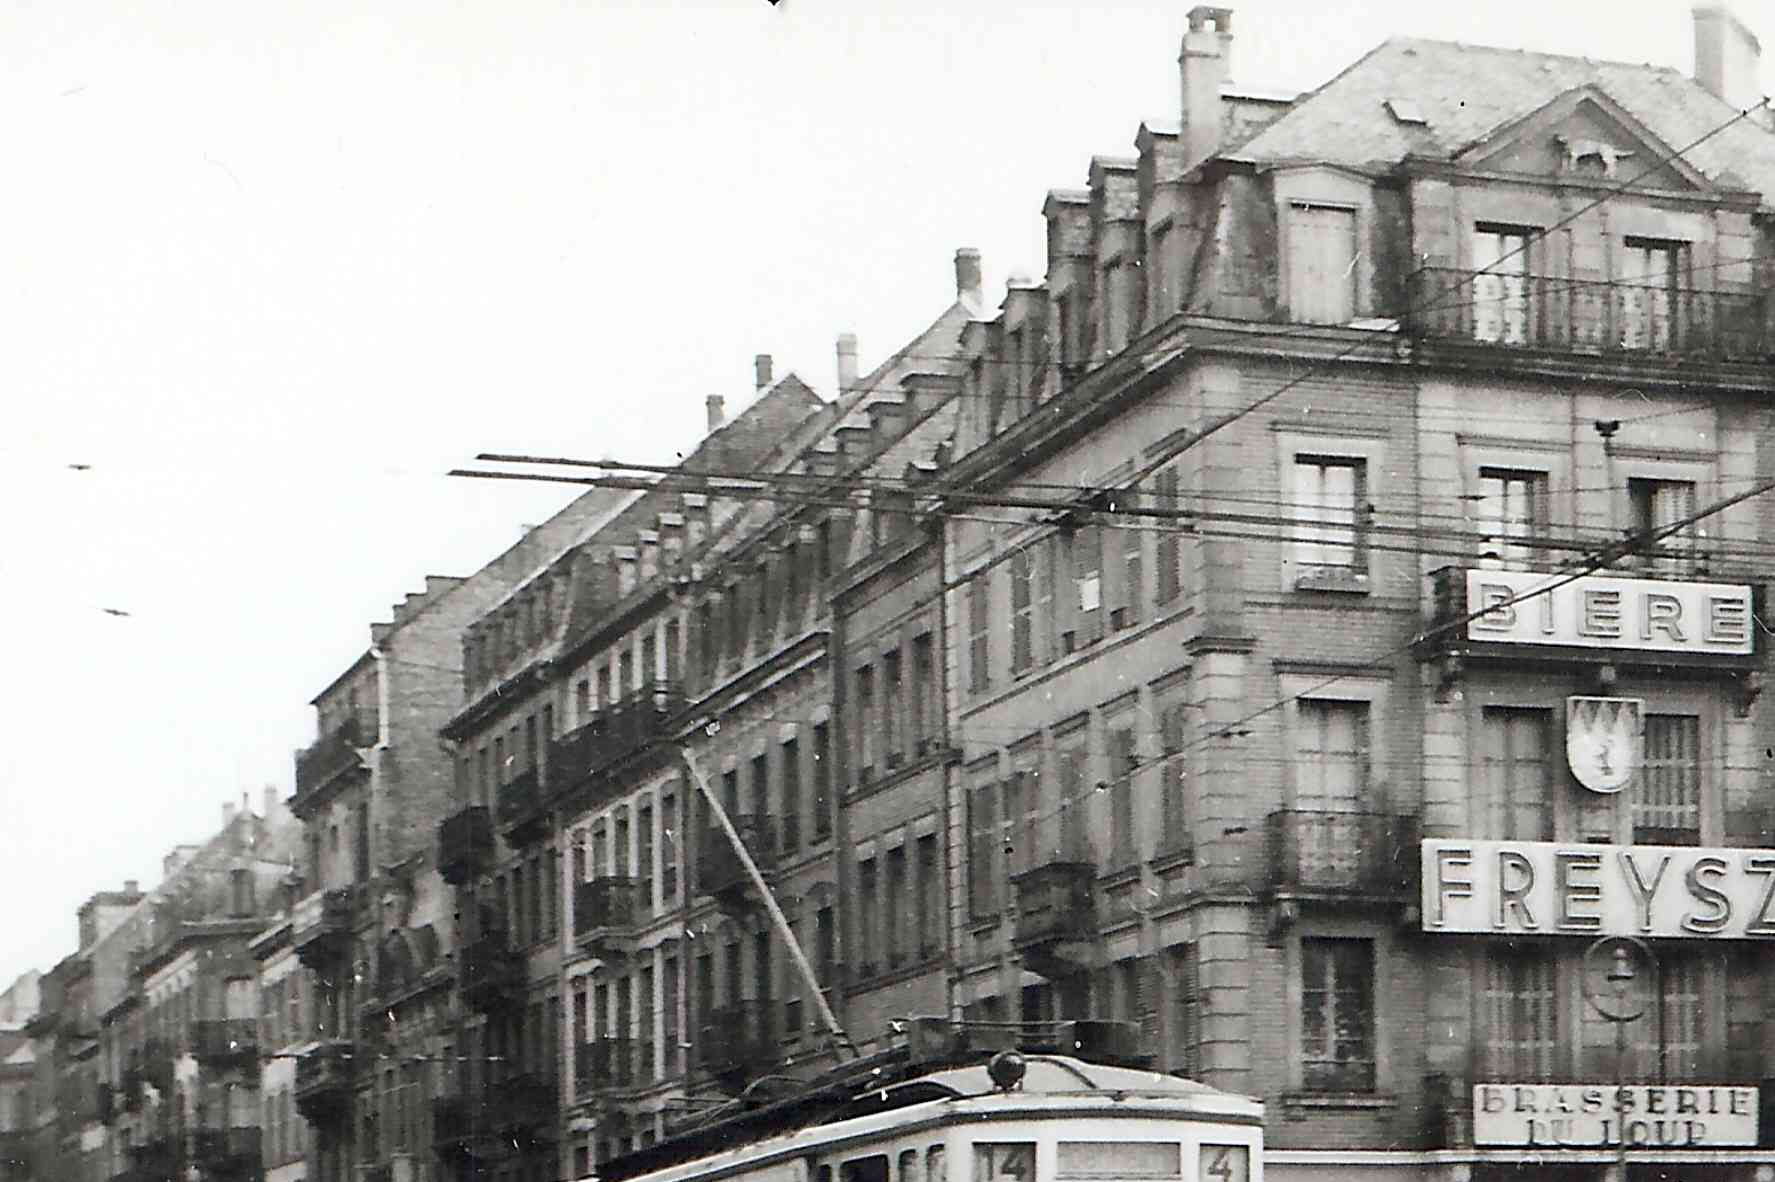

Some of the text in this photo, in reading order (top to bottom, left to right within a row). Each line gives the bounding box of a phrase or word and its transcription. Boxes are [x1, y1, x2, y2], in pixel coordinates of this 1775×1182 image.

[1475, 583, 1748, 643] BIERE
[1480, 1086, 1752, 1115] BRASSERIE
[1526, 1118, 1707, 1146] DU LOUP
[980, 1150, 1027, 1182] 14
[1207, 1148, 1232, 1182] 4
